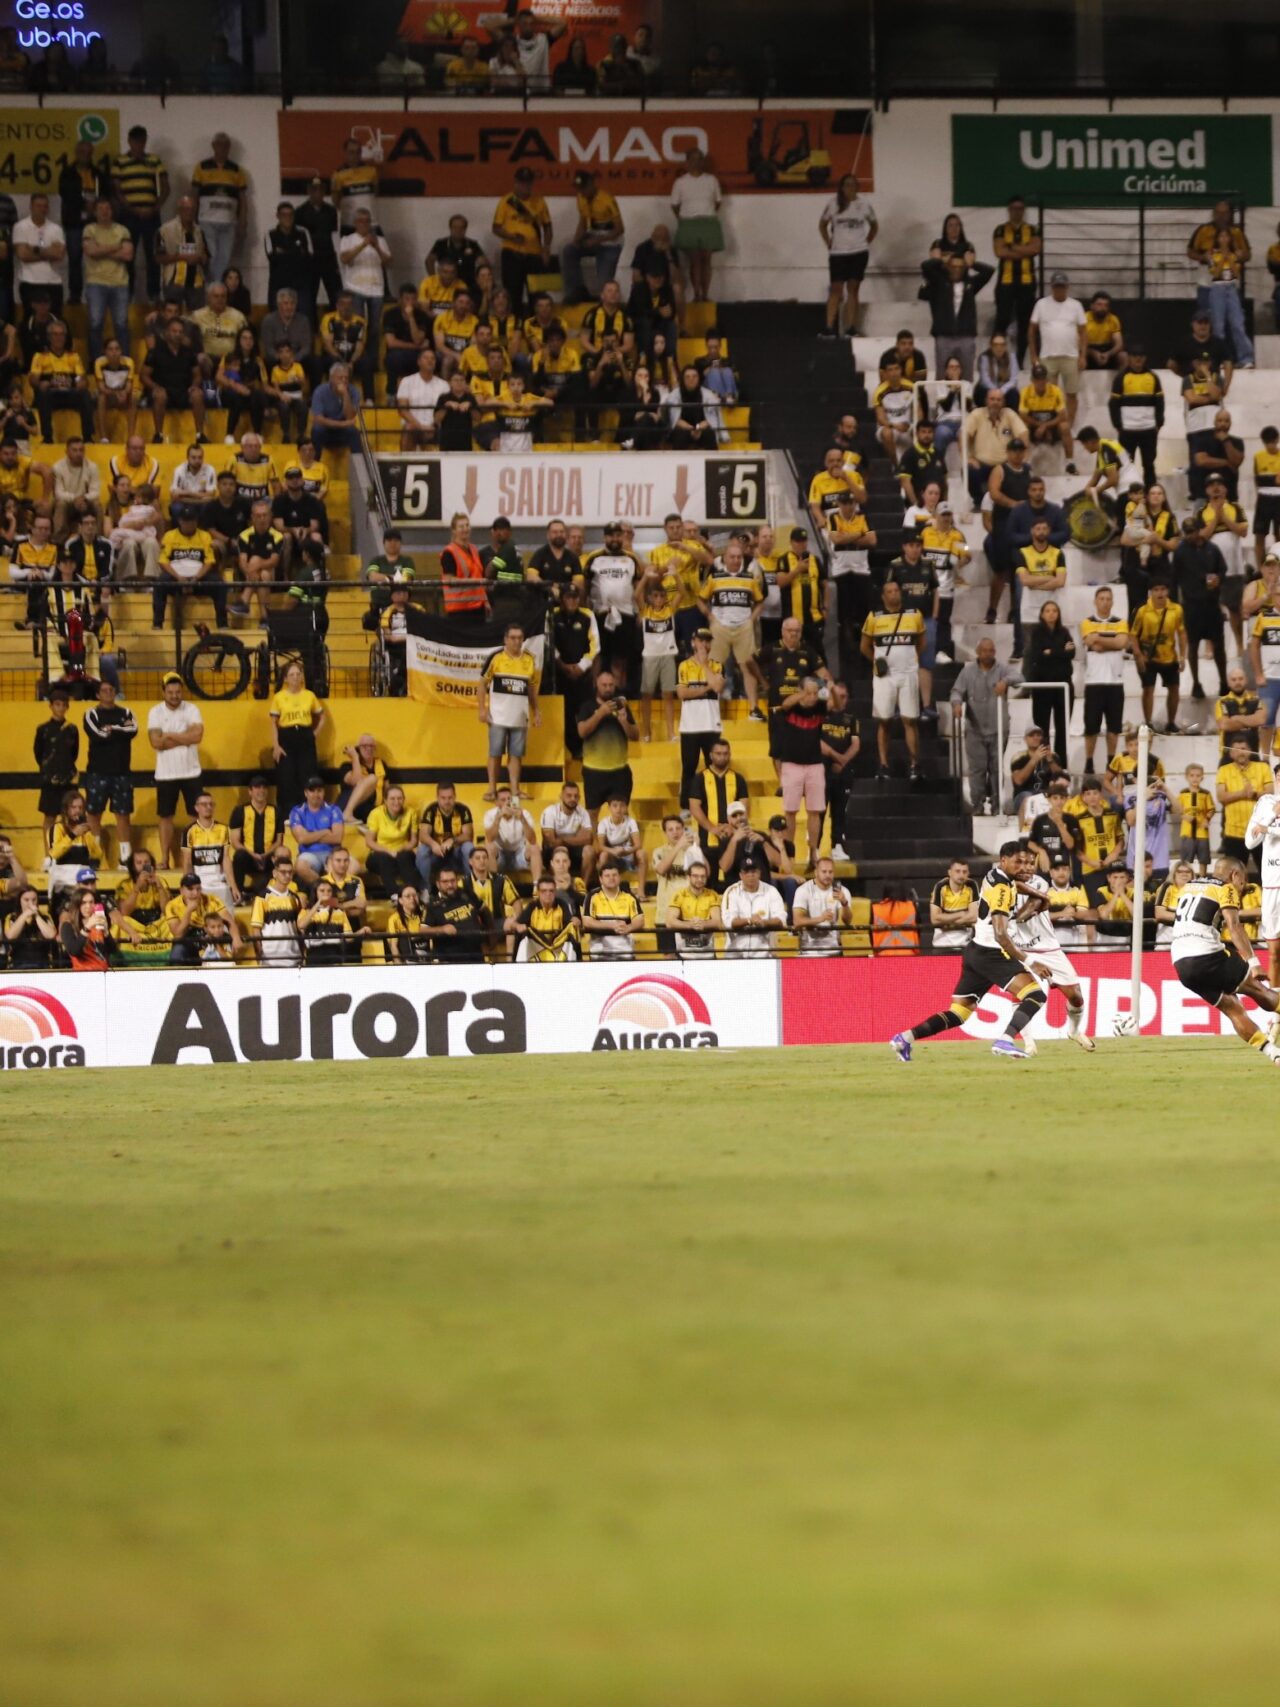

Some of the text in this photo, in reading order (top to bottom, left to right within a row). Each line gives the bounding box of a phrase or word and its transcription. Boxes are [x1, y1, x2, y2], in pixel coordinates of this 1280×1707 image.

[387, 124, 710, 163] ALFAMAQ
[1019, 129, 1206, 170] Unimed
[1124, 173, 1206, 195] Criciúma
[403, 464, 430, 516] 5
[498, 462, 655, 517] SAÍDA EXIT
[732, 464, 758, 516] 5
[151, 982, 527, 1065] Aurora
[592, 1028, 719, 1051] Aurora
